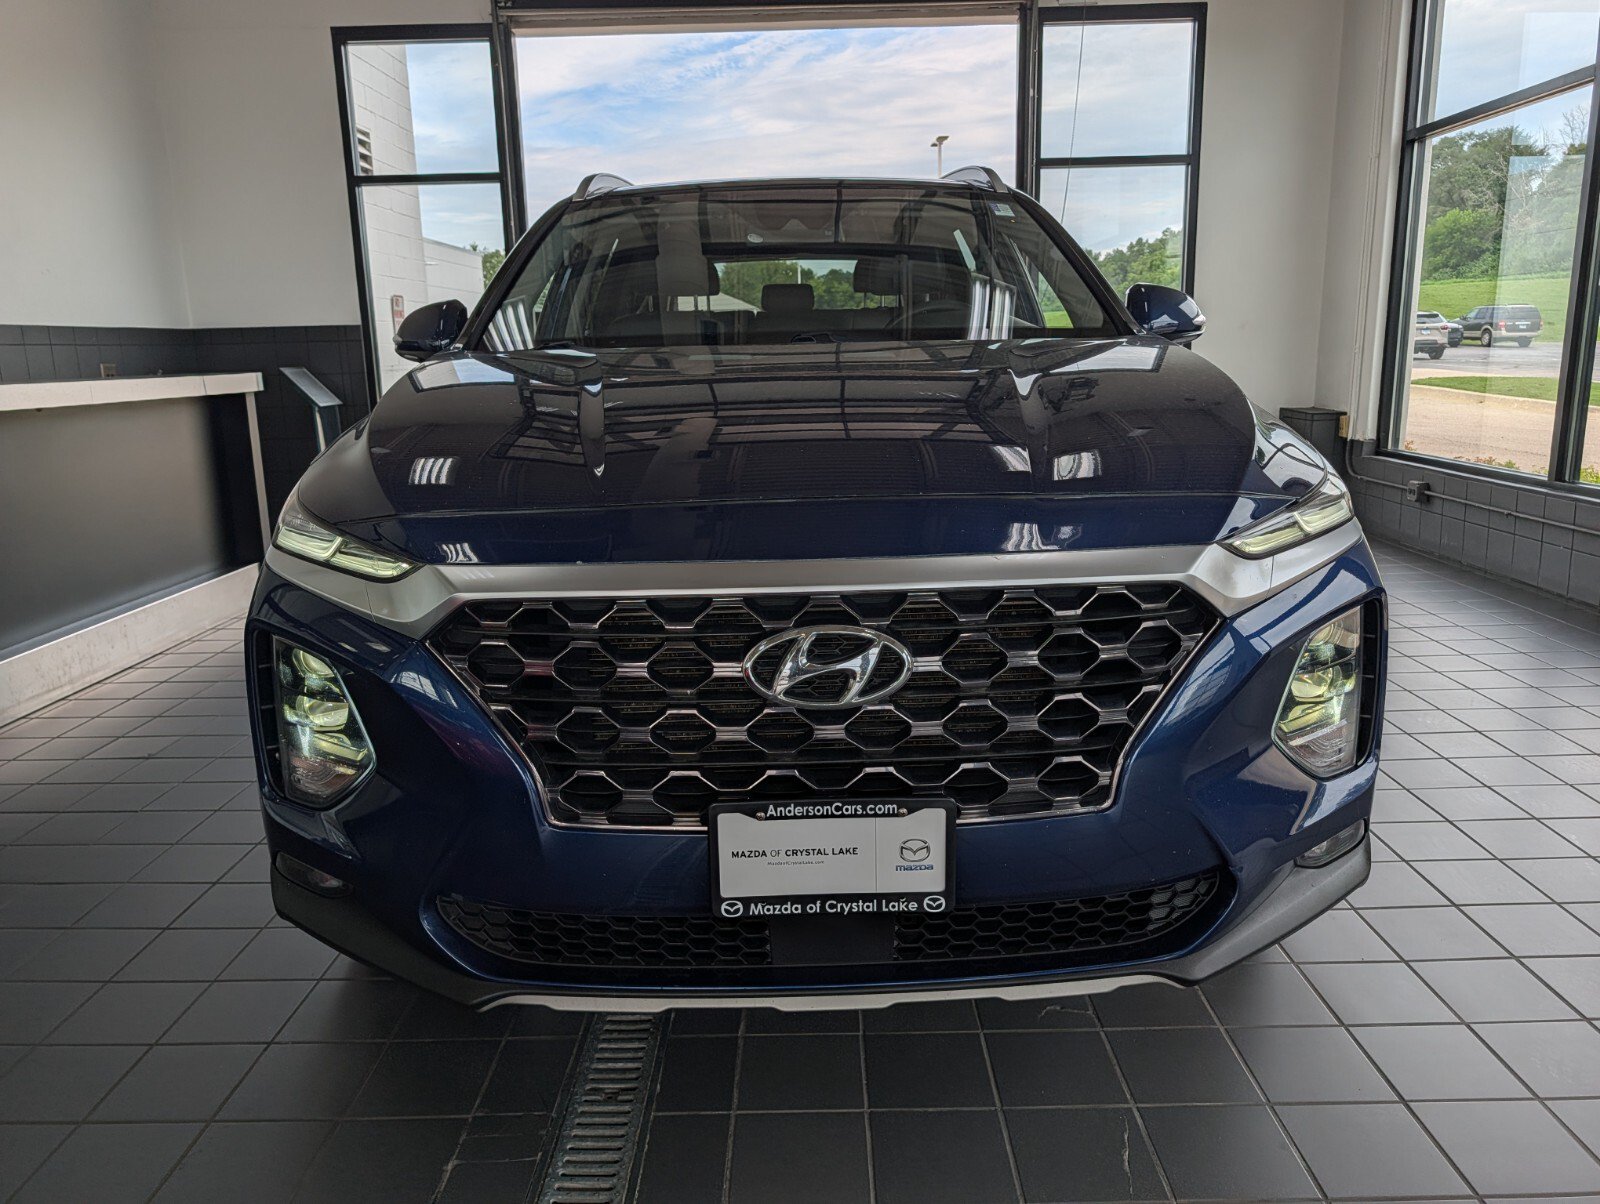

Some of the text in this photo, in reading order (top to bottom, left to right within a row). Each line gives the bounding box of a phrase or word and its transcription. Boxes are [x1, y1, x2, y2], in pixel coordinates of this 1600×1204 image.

[766, 802, 898, 817] AndersonCars.com
[731, 847, 859, 859] MAZDA OF CRYSTAL LAKE
[749, 898, 918, 916] Mazda of Crystal Lake
